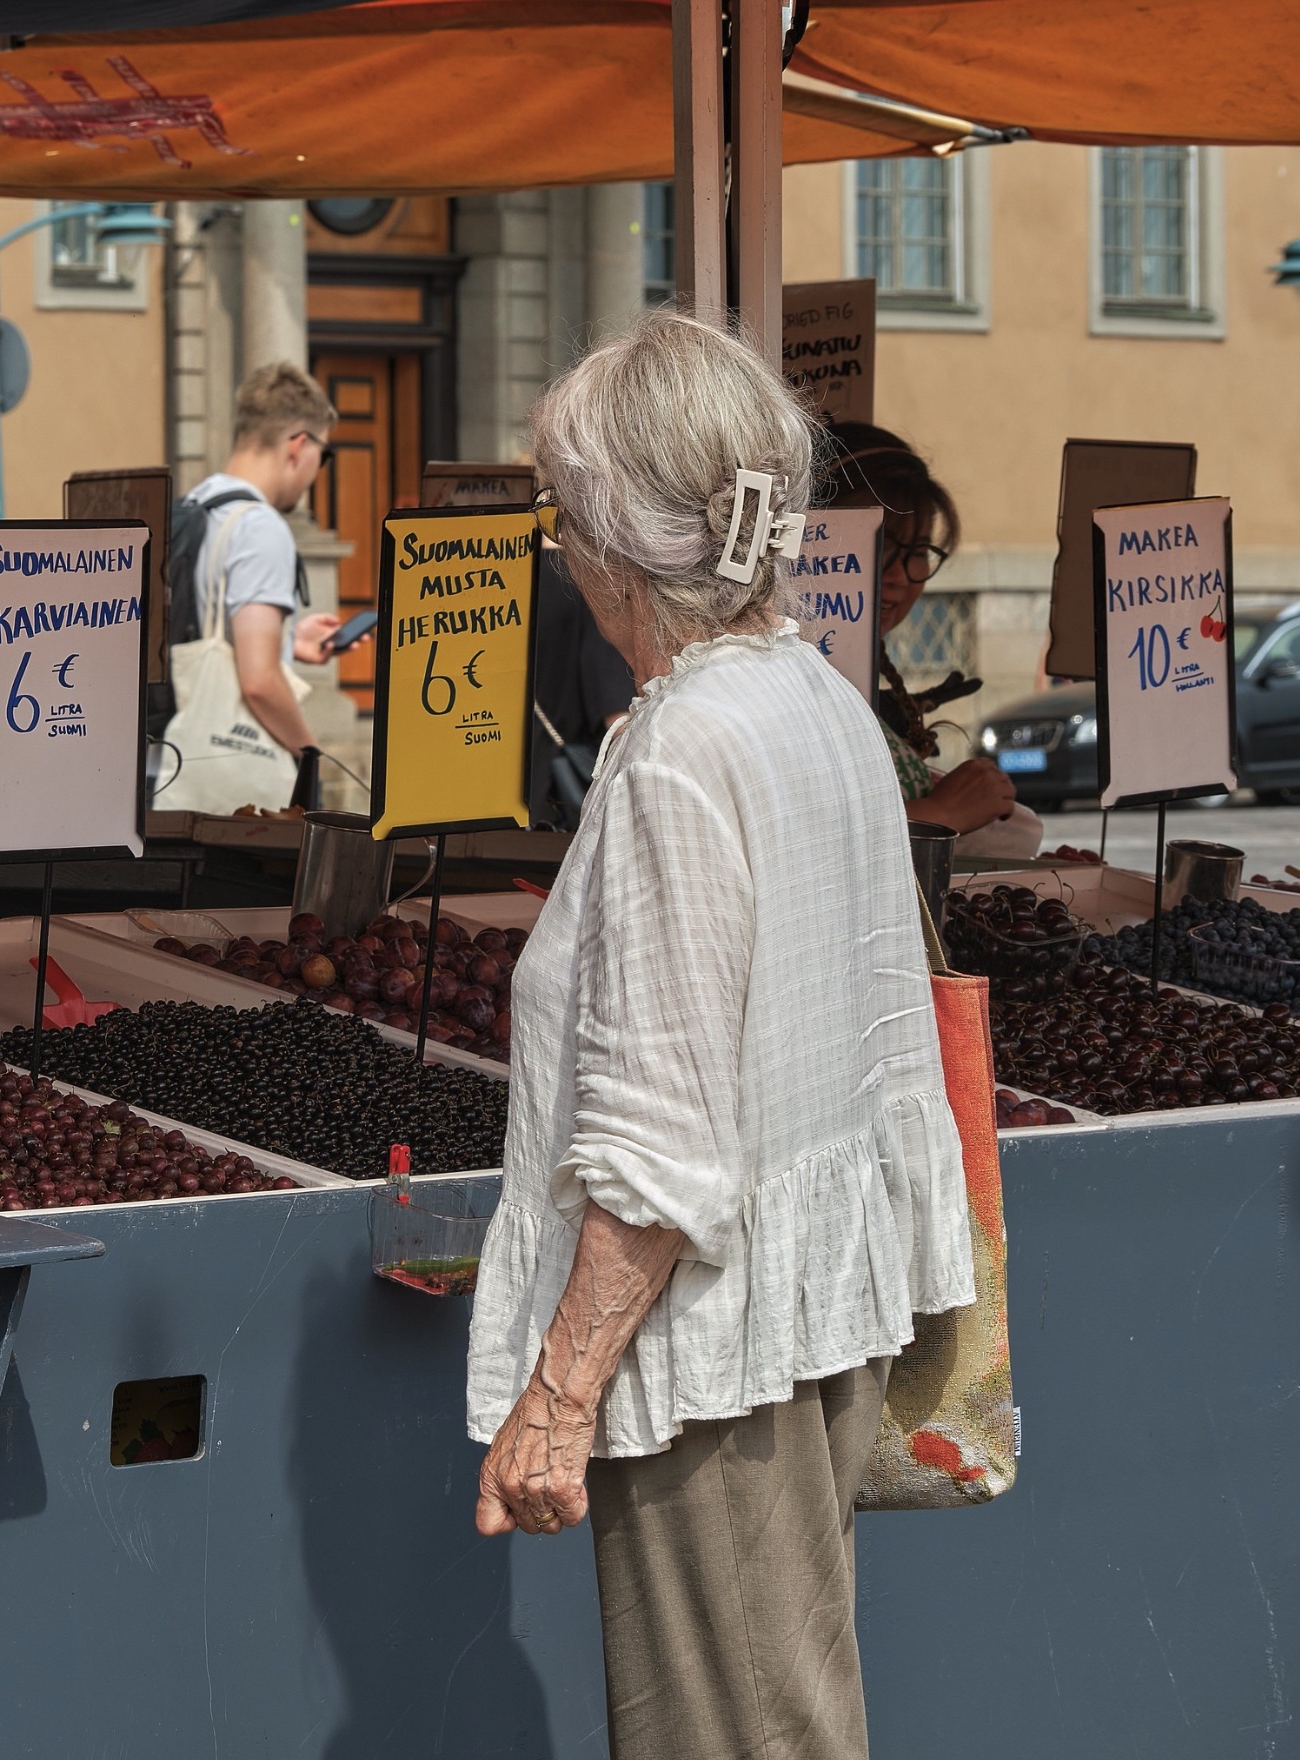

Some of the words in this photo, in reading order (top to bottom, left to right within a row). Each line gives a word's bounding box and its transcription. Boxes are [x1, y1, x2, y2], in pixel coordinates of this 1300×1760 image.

[825, 302, 854, 321] FIG
[456, 478, 509, 496] MAKEA
[399, 528, 536, 570] SUOMALAINEN
[1119, 523, 1199, 555] MAKEA
[420, 568, 506, 600] MUSTA
[1108, 568, 1225, 612] KIRSIKKA
[398, 599, 522, 648] HERUKKA
[1128, 624, 1170, 690] 10
[1176, 627, 1193, 650] €
[6, 651, 41, 733] 6
[52, 654, 80, 689] €
[421, 641, 456, 716] 6
[462, 650, 487, 689] €
[50, 703, 83, 717] LITRA
[462, 710, 495, 723] LITRA
[47, 723, 87, 737] SUOMI
[464, 731, 501, 746] SUOMI
